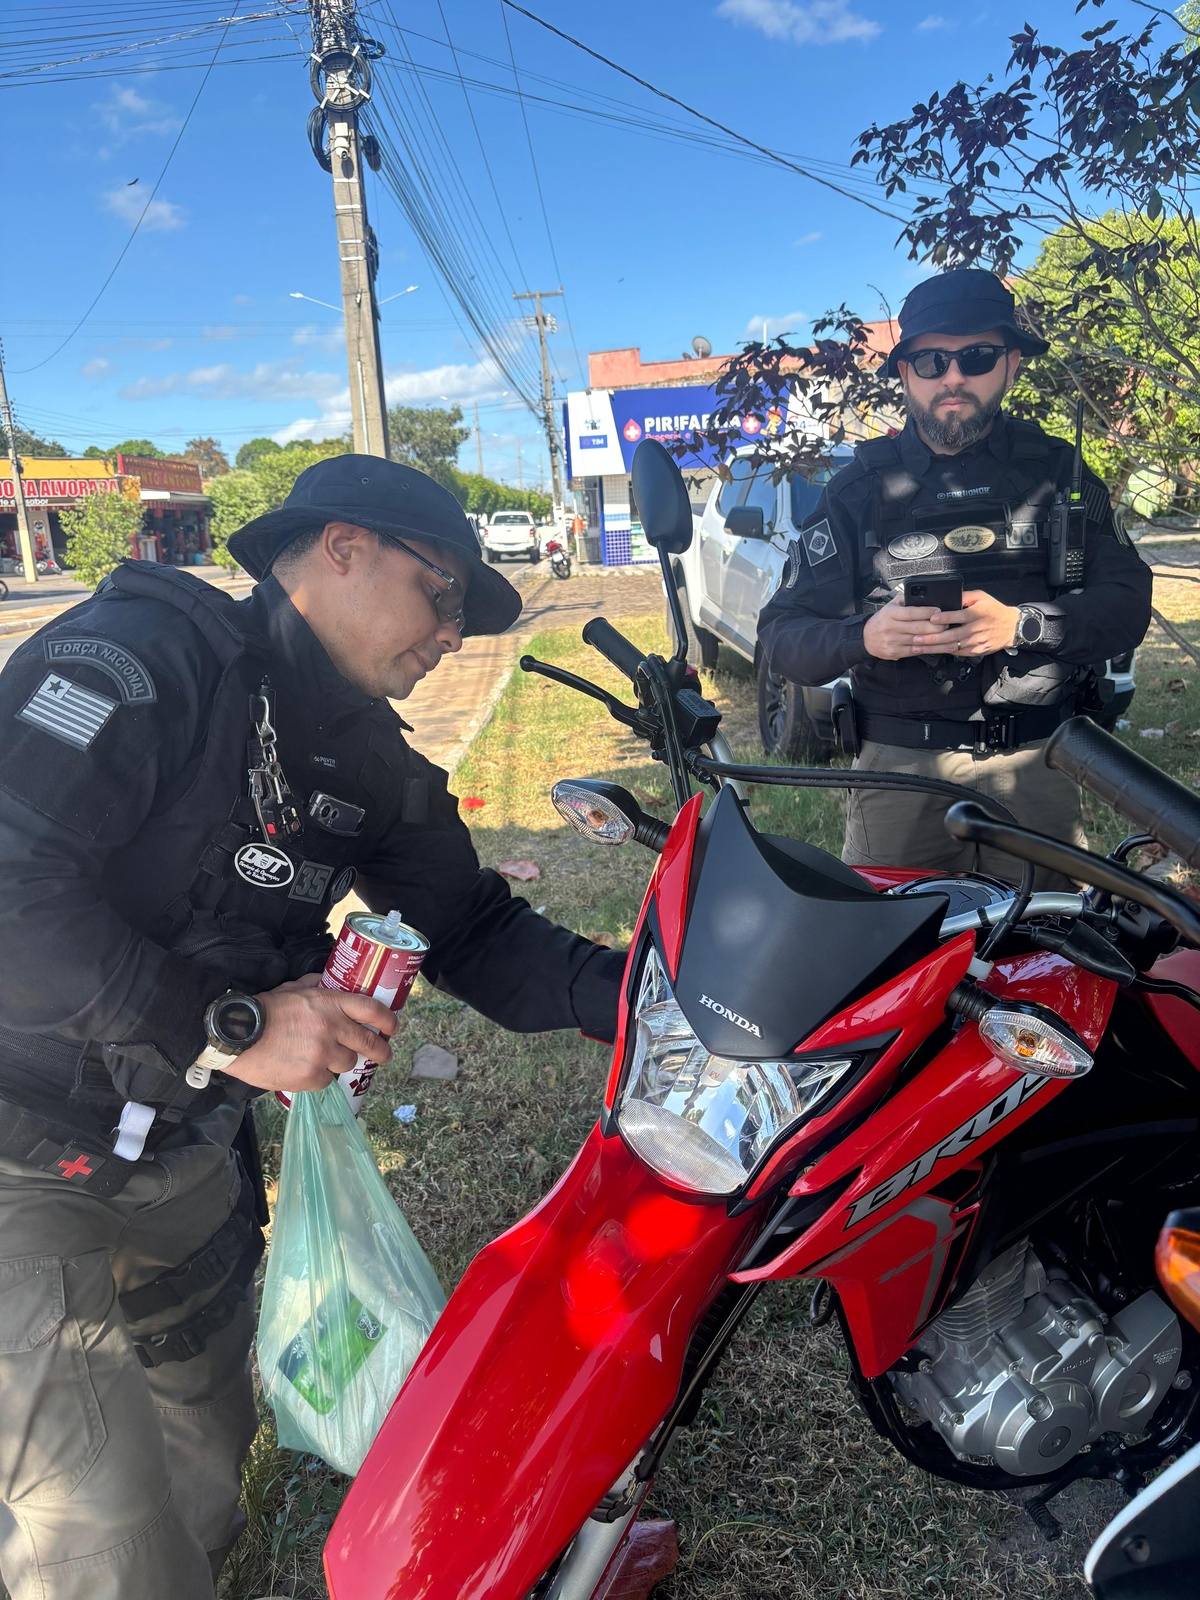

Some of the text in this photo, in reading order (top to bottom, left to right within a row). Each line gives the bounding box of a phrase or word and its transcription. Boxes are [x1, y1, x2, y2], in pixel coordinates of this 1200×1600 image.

[1010, 526, 1035, 546] 06
[54, 642, 145, 697] FORÇA NACIONAL
[240, 846, 288, 874] DOT
[295, 866, 327, 898] 35
[699, 993, 761, 1038] HONDA
[843, 1072, 1051, 1232] BROS
